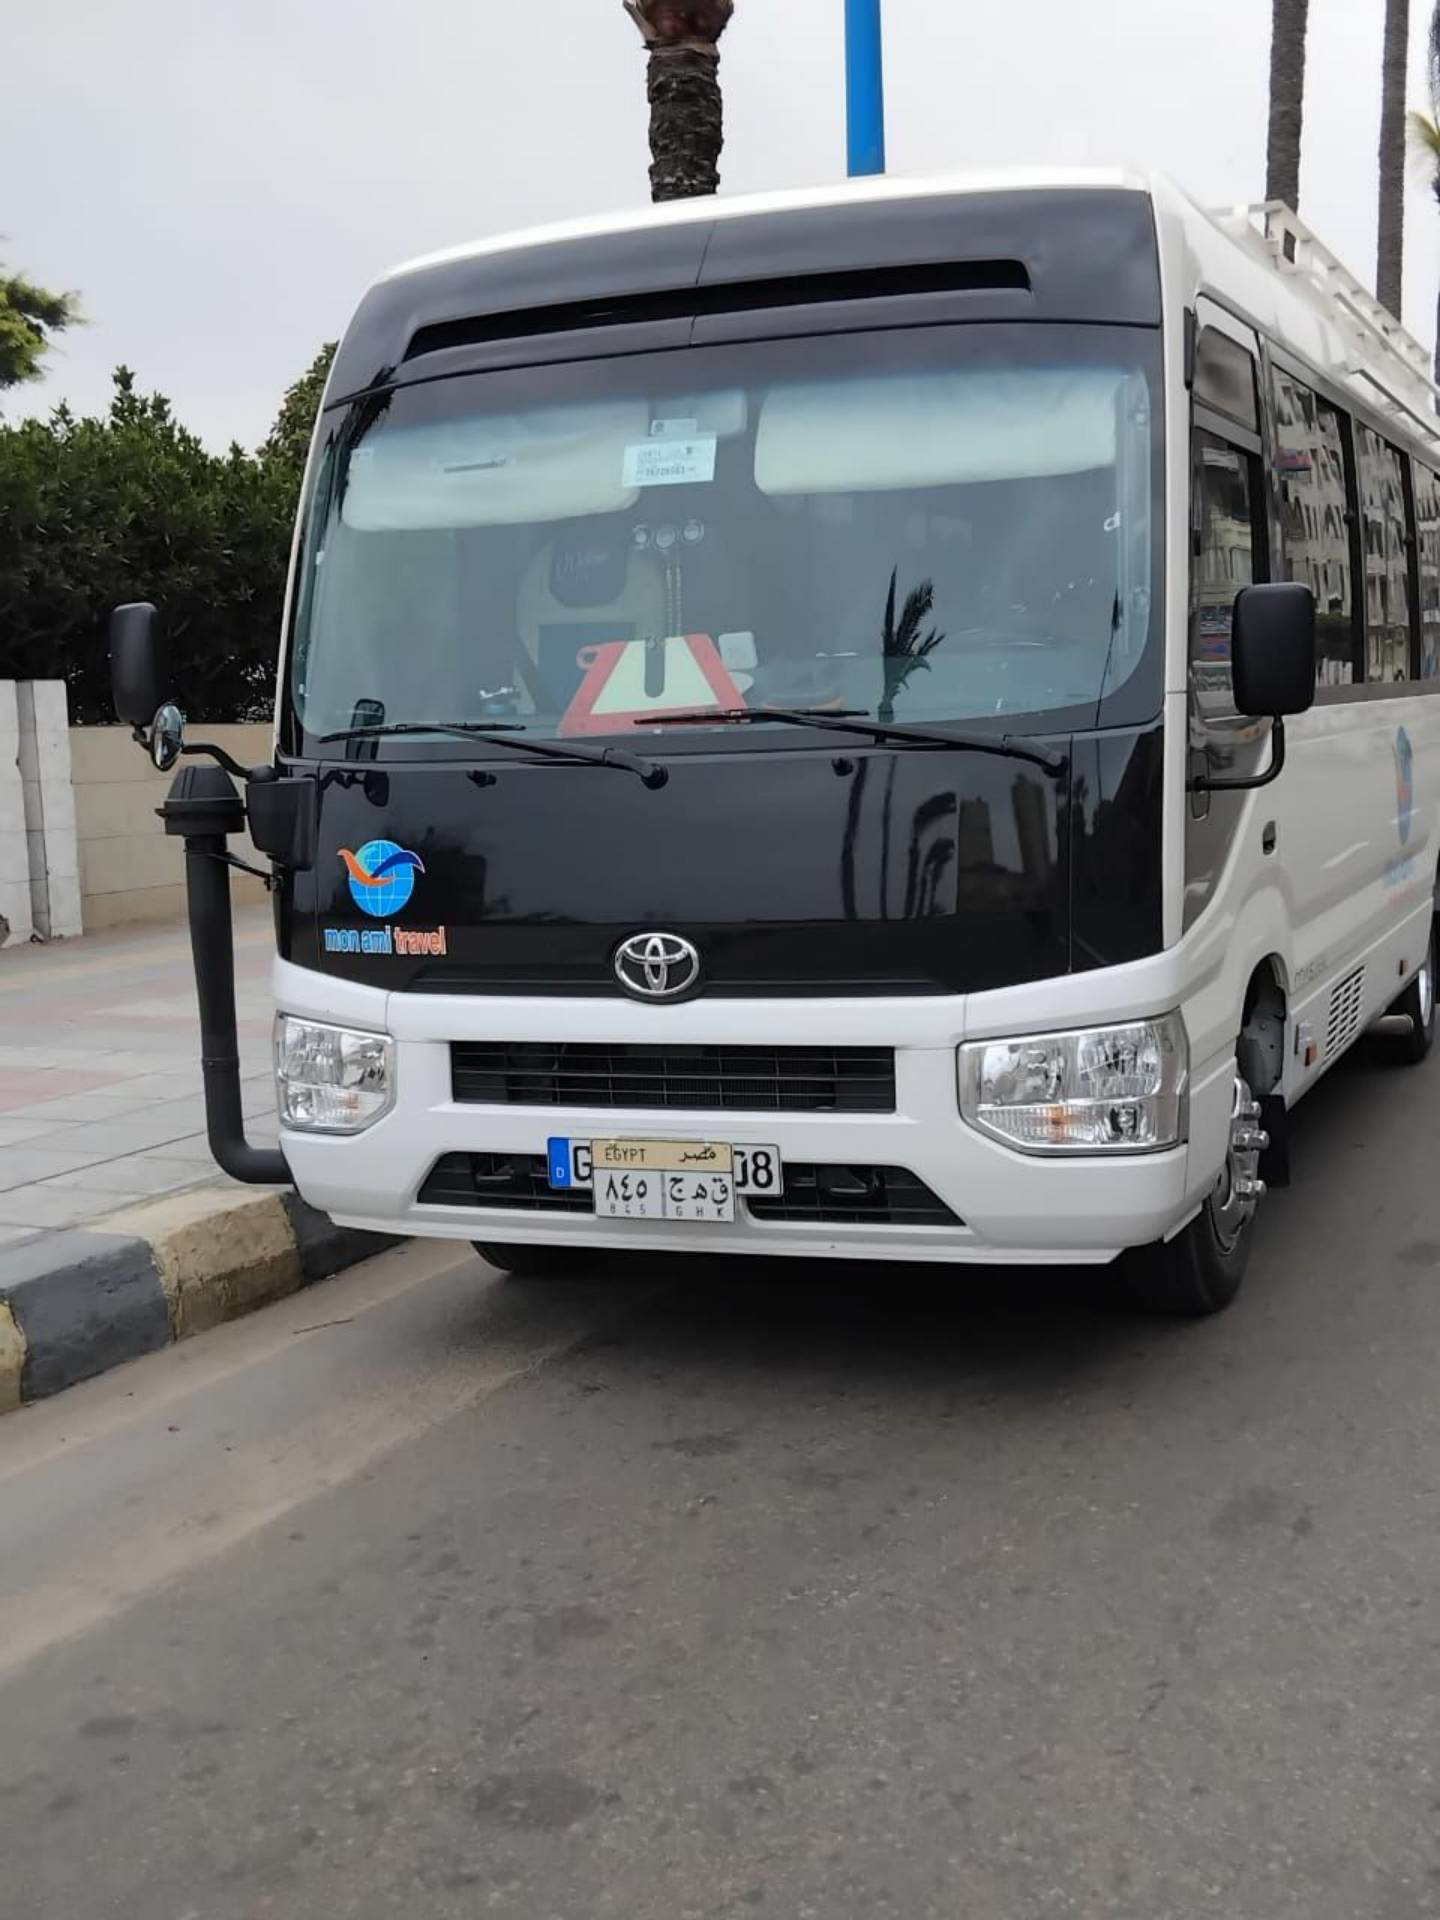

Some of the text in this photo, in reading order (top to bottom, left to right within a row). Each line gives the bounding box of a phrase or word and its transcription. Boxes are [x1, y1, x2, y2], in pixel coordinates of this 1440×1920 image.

[324, 925, 447, 955] mon ami travel
[555, 1166, 565, 1178] D
[573, 1145, 592, 1182] G
[605, 1147, 647, 1161] EGYPT
[678, 1146, 717, 1162] مصر
